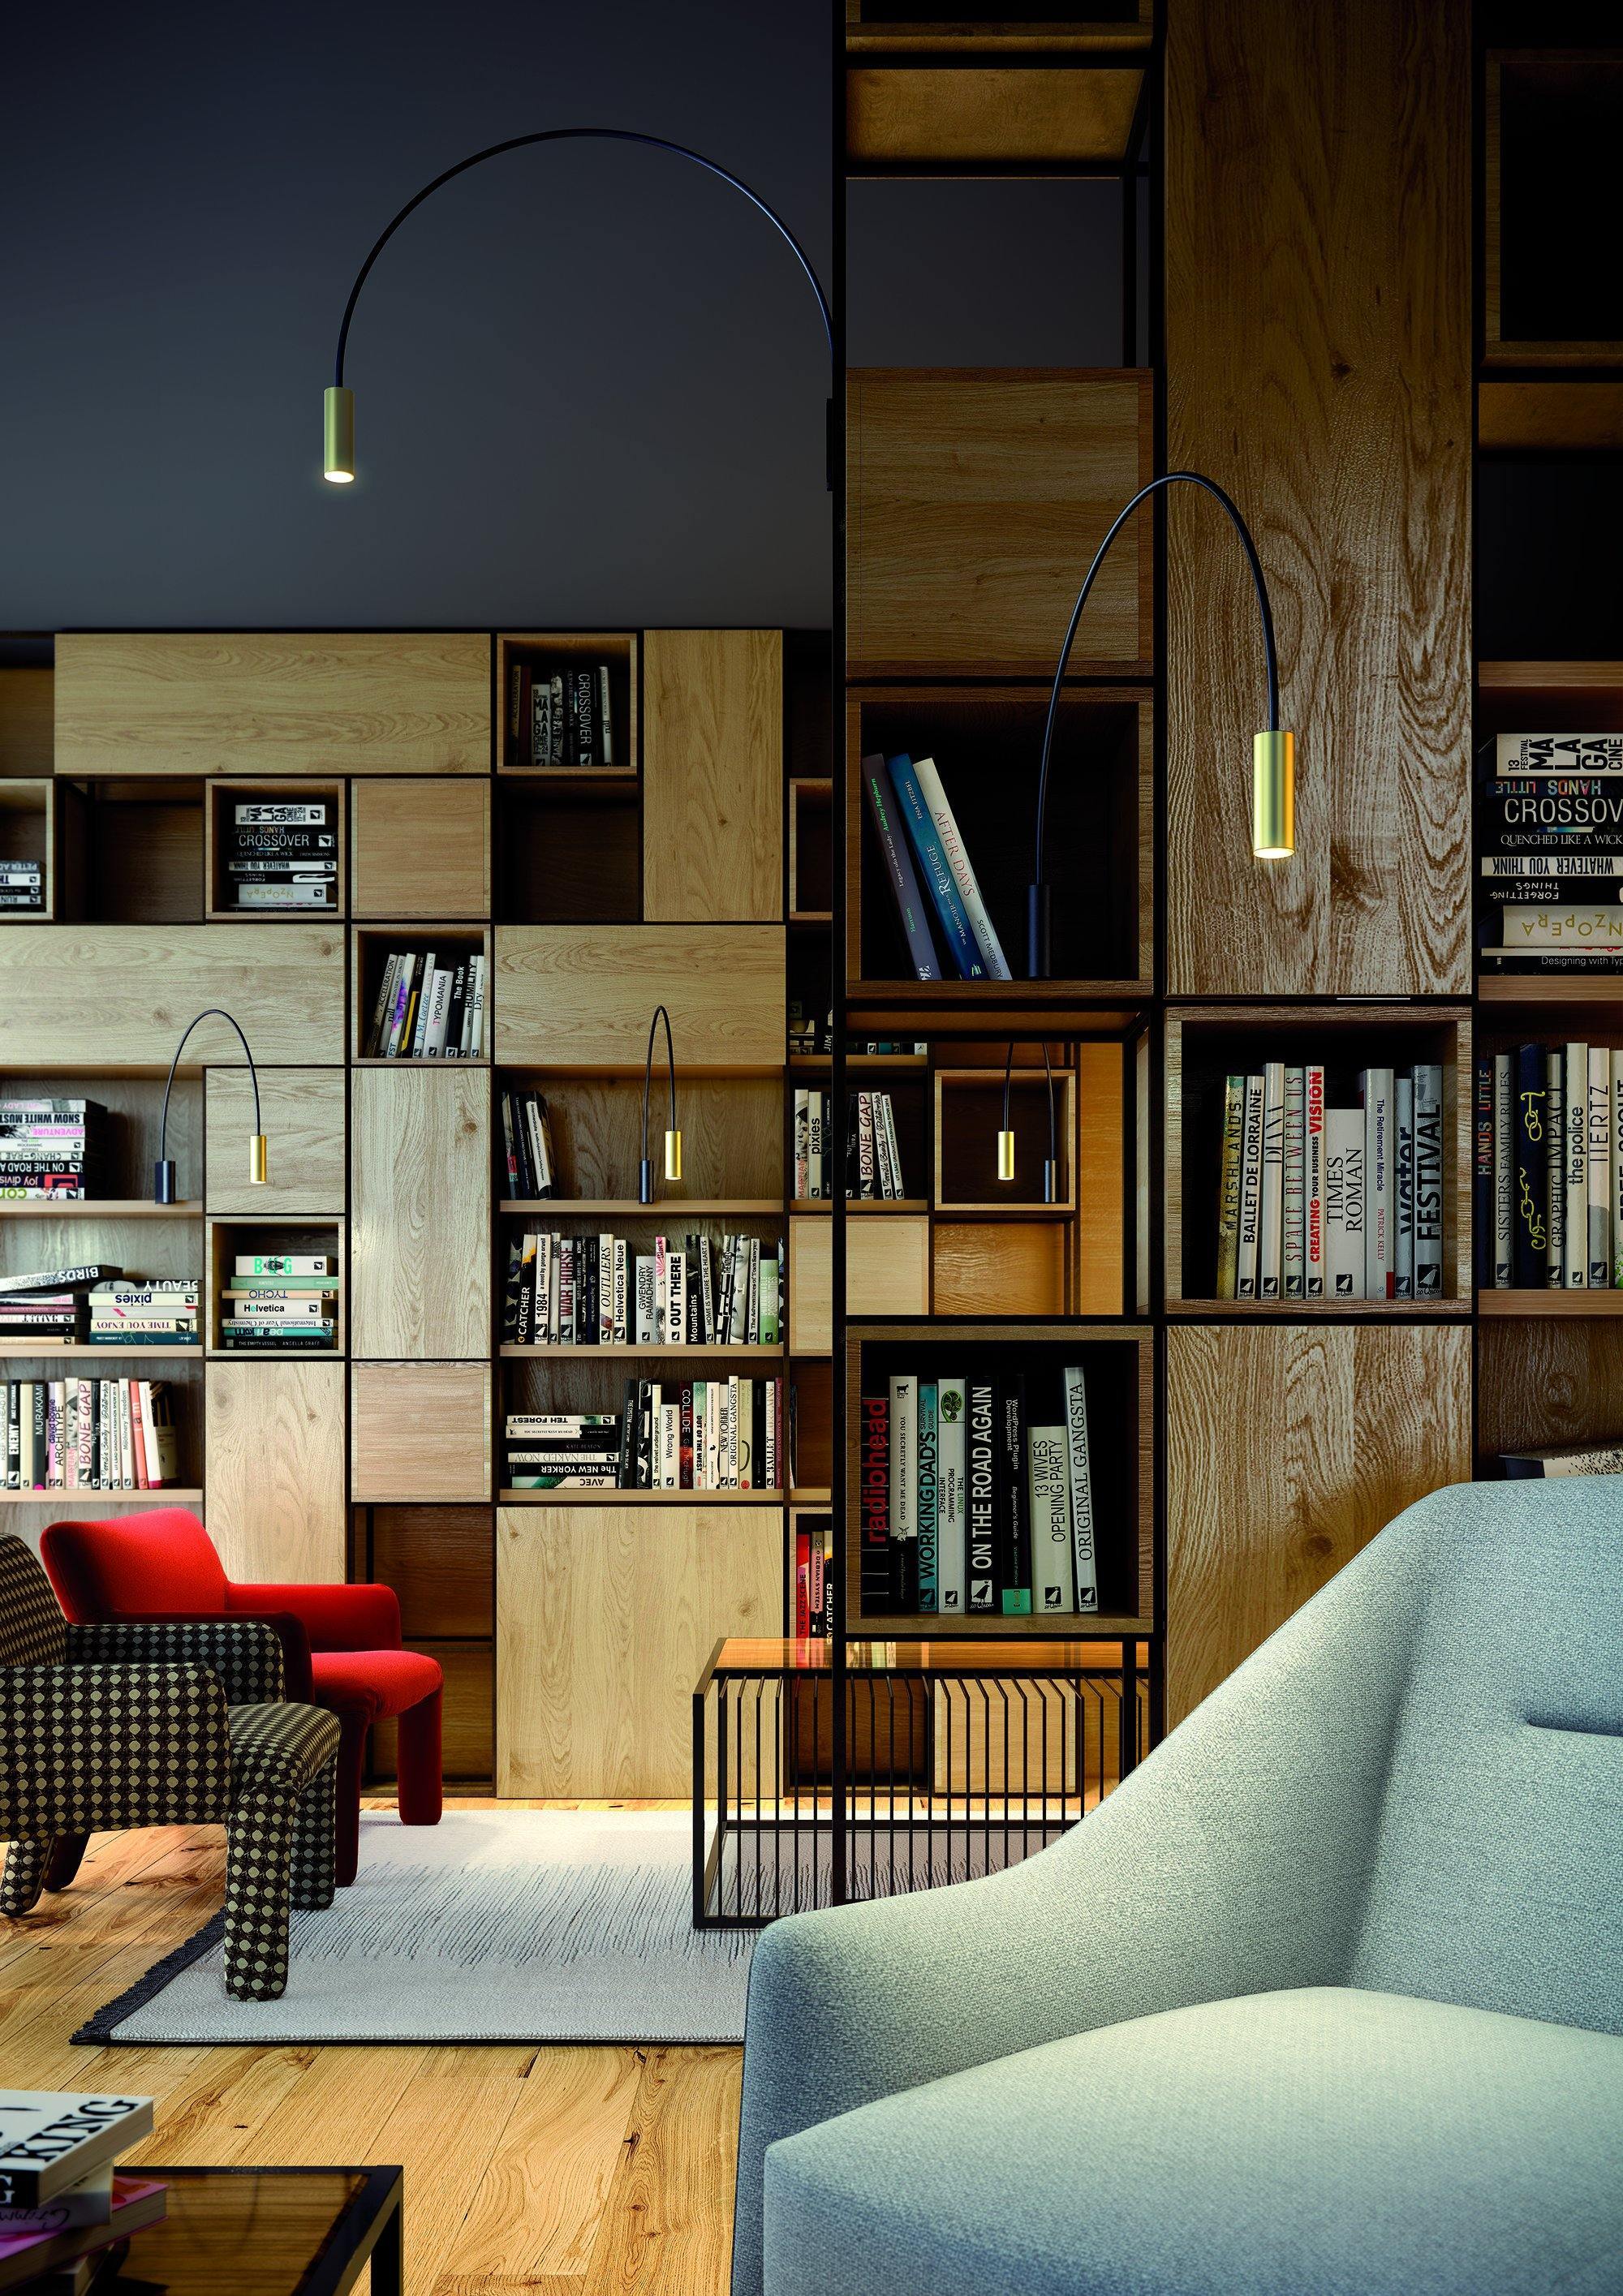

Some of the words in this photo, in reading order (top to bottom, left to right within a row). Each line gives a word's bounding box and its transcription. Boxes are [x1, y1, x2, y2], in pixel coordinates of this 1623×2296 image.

[578, 673, 591, 745] CROSSOVER
[1508, 759, 1520, 771] 13
[1555, 738, 1581, 771] LA
[1582, 738, 1608, 771] GA
[1608, 738, 1623, 771] CINE
[870, 778, 885, 807] Hepburn
[1496, 781, 1536, 794] LITTLE
[1548, 780, 1602, 795] HANDS
[878, 808, 890, 832] Audrey
[239, 834, 310, 847] CROSSOVER
[934, 811, 960, 854] AFTER
[952, 858, 975, 896] DAYS
[1501, 834, 1558, 847] QUENCHED
[1561, 835, 1581, 845] LIKE
[1584, 835, 1591, 845] A
[1493, 858, 1524, 875] THINK
[1529, 858, 1550, 875] YOU
[1556, 858, 1614, 875] WHATEVER
[1490, 891, 1560, 899] FORGETTING
[1516, 882, 1560, 890] THINGS
[976, 918, 992, 941] SCOTT
[984, 943, 1004, 978] MEDBURY
[1542, 956, 1586, 967] Designing
[1589, 956, 1608, 965] with
[378, 959, 395, 1008] ACCELERATION
[456, 966, 464, 985] Book
[465, 963, 477, 1008] HUMILITY
[433, 975, 446, 1025] TYPOMANIA
[454, 987, 463, 1000] The
[474, 993, 484, 1010] Dry
[824, 1034, 833, 1051] JIM
[1285, 1077, 1302, 1098] US
[1308, 1072, 1323, 1134] VISION
[1500, 1071, 1512, 1118] RULES
[24, 1114, 52, 1123] WHITE
[54, 1114, 80, 1123] SNOW
[859, 1095, 872, 1128] GAP
[32, 1128, 84, 1136] ADVENTURE
[809, 1118, 821, 1154] pixies
[1376, 1116, 1384, 1160] Retirement
[1500, 1120, 1512, 1170] FAMILY
[1568, 1106, 1587, 1154] police
[861, 1133, 873, 1176] BONE
[1225, 1102, 1242, 1230] MARSHLANDS
[1285, 1108, 1302, 1195] BETWEEN
[1311, 1136, 1319, 1174] BUSINESS
[8, 1163, 32, 1172] ROAD
[24, 1176, 39, 1187] joy
[34, 1163, 50, 1172] THE
[52, 1163, 65, 1172] ON
[1247, 1167, 1259, 1186] DE
[1376, 1162, 1384, 1192] Miracle
[1417, 1104, 1441, 1240] FESTIVAL
[1568, 1159, 1584, 1185] the
[1311, 1175, 1319, 1198] YOUR
[1326, 1157, 1344, 1225] TIMES
[1345, 1148, 1363, 1232] ROMAN
[1243, 1190, 1256, 1244] BALLET
[1498, 1175, 1512, 1241] SISTERS
[1285, 1206, 1302, 1262] SPACE
[1310, 1199, 1321, 1262] CREATING
[615, 1245, 624, 1271] Neue
[58, 1266, 99, 1282] BIRDS
[601, 1246, 611, 1308] OUTLIERS
[670, 1256, 682, 1299] THERE
[115, 1293, 152, 1306] pixies
[243, 1304, 285, 1313] Helvetica
[248, 1290, 288, 1298] TYCHO
[536, 1293, 548, 1318] 1984
[615, 1274, 624, 1322] Helvetica
[94, 1321, 125, 1329] ENJOY
[127, 1321, 147, 1329] YOU
[149, 1321, 171, 1329] TIME
[227, 1319, 257, 1327] Chemistry
[518, 1287, 531, 1335] CATCHER
[670, 1300, 682, 1326] OUT
[690, 1294, 698, 1342] Mountains
[36, 1385, 44, 1435] MURAKAMI
[80, 1384, 92, 1415] GAP
[682, 1389, 691, 1433] COLLIDE
[972, 1387, 992, 1443] AGAIN
[55, 1405, 63, 1466] ARCHITYPE
[696, 1430, 703, 1438] OF
[1005, 1400, 1013, 1451] Development
[1011, 1399, 1019, 1443] WordPress
[1070, 1382, 1089, 1468] GANGSTA
[8, 1423, 19, 1455] ENEMY
[80, 1421, 91, 1464] BONE
[665, 1433, 674, 1459] Wrong
[540, 1465, 576, 1473] YORKER
[579, 1465, 599, 1473] NEW
[601, 1465, 617, 1473] The
[863, 1399, 887, 1542] radiohead
[919, 1431, 936, 1488] DAD'S
[972, 1447, 992, 1498] ROAD
[1011, 1444, 1019, 1470] Plugin
[1033, 1441, 1048, 1483] WIVES
[1048, 1440, 1063, 1480] PARTY
[579, 1478, 605, 1486] AVEC
[900, 1490, 906, 1499] ME
[1035, 1485, 1048, 1498] 13
[972, 1504, 992, 1538] THE
[1050, 1485, 1065, 1542] OPENING
[1075, 1473, 1092, 1561] ORIGINAL
[919, 1490, 936, 1580] WORKING
[972, 1544, 992, 1569] ON
